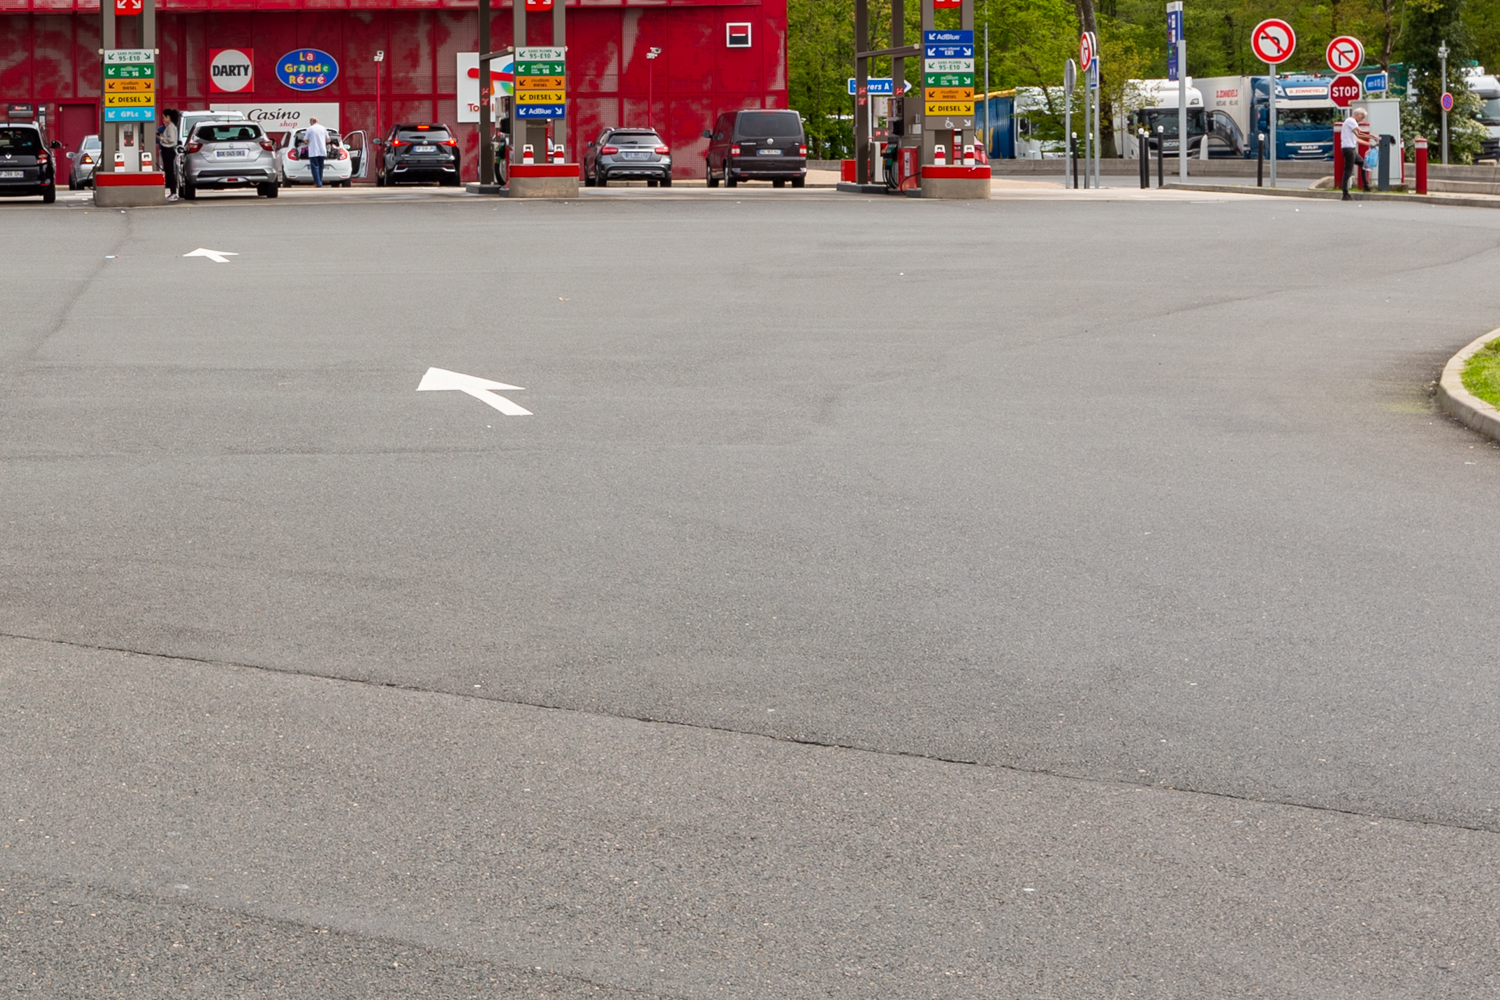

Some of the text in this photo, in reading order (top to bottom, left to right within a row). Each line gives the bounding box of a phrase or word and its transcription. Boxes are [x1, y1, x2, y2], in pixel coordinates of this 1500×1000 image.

[300, 52, 313, 60] La
[212, 65, 250, 76] DARTY
[285, 64, 329, 72] Grande
[289, 74, 324, 84] Récré
[1332, 86, 1358, 97] STOP
[248, 108, 300, 120] Casino
